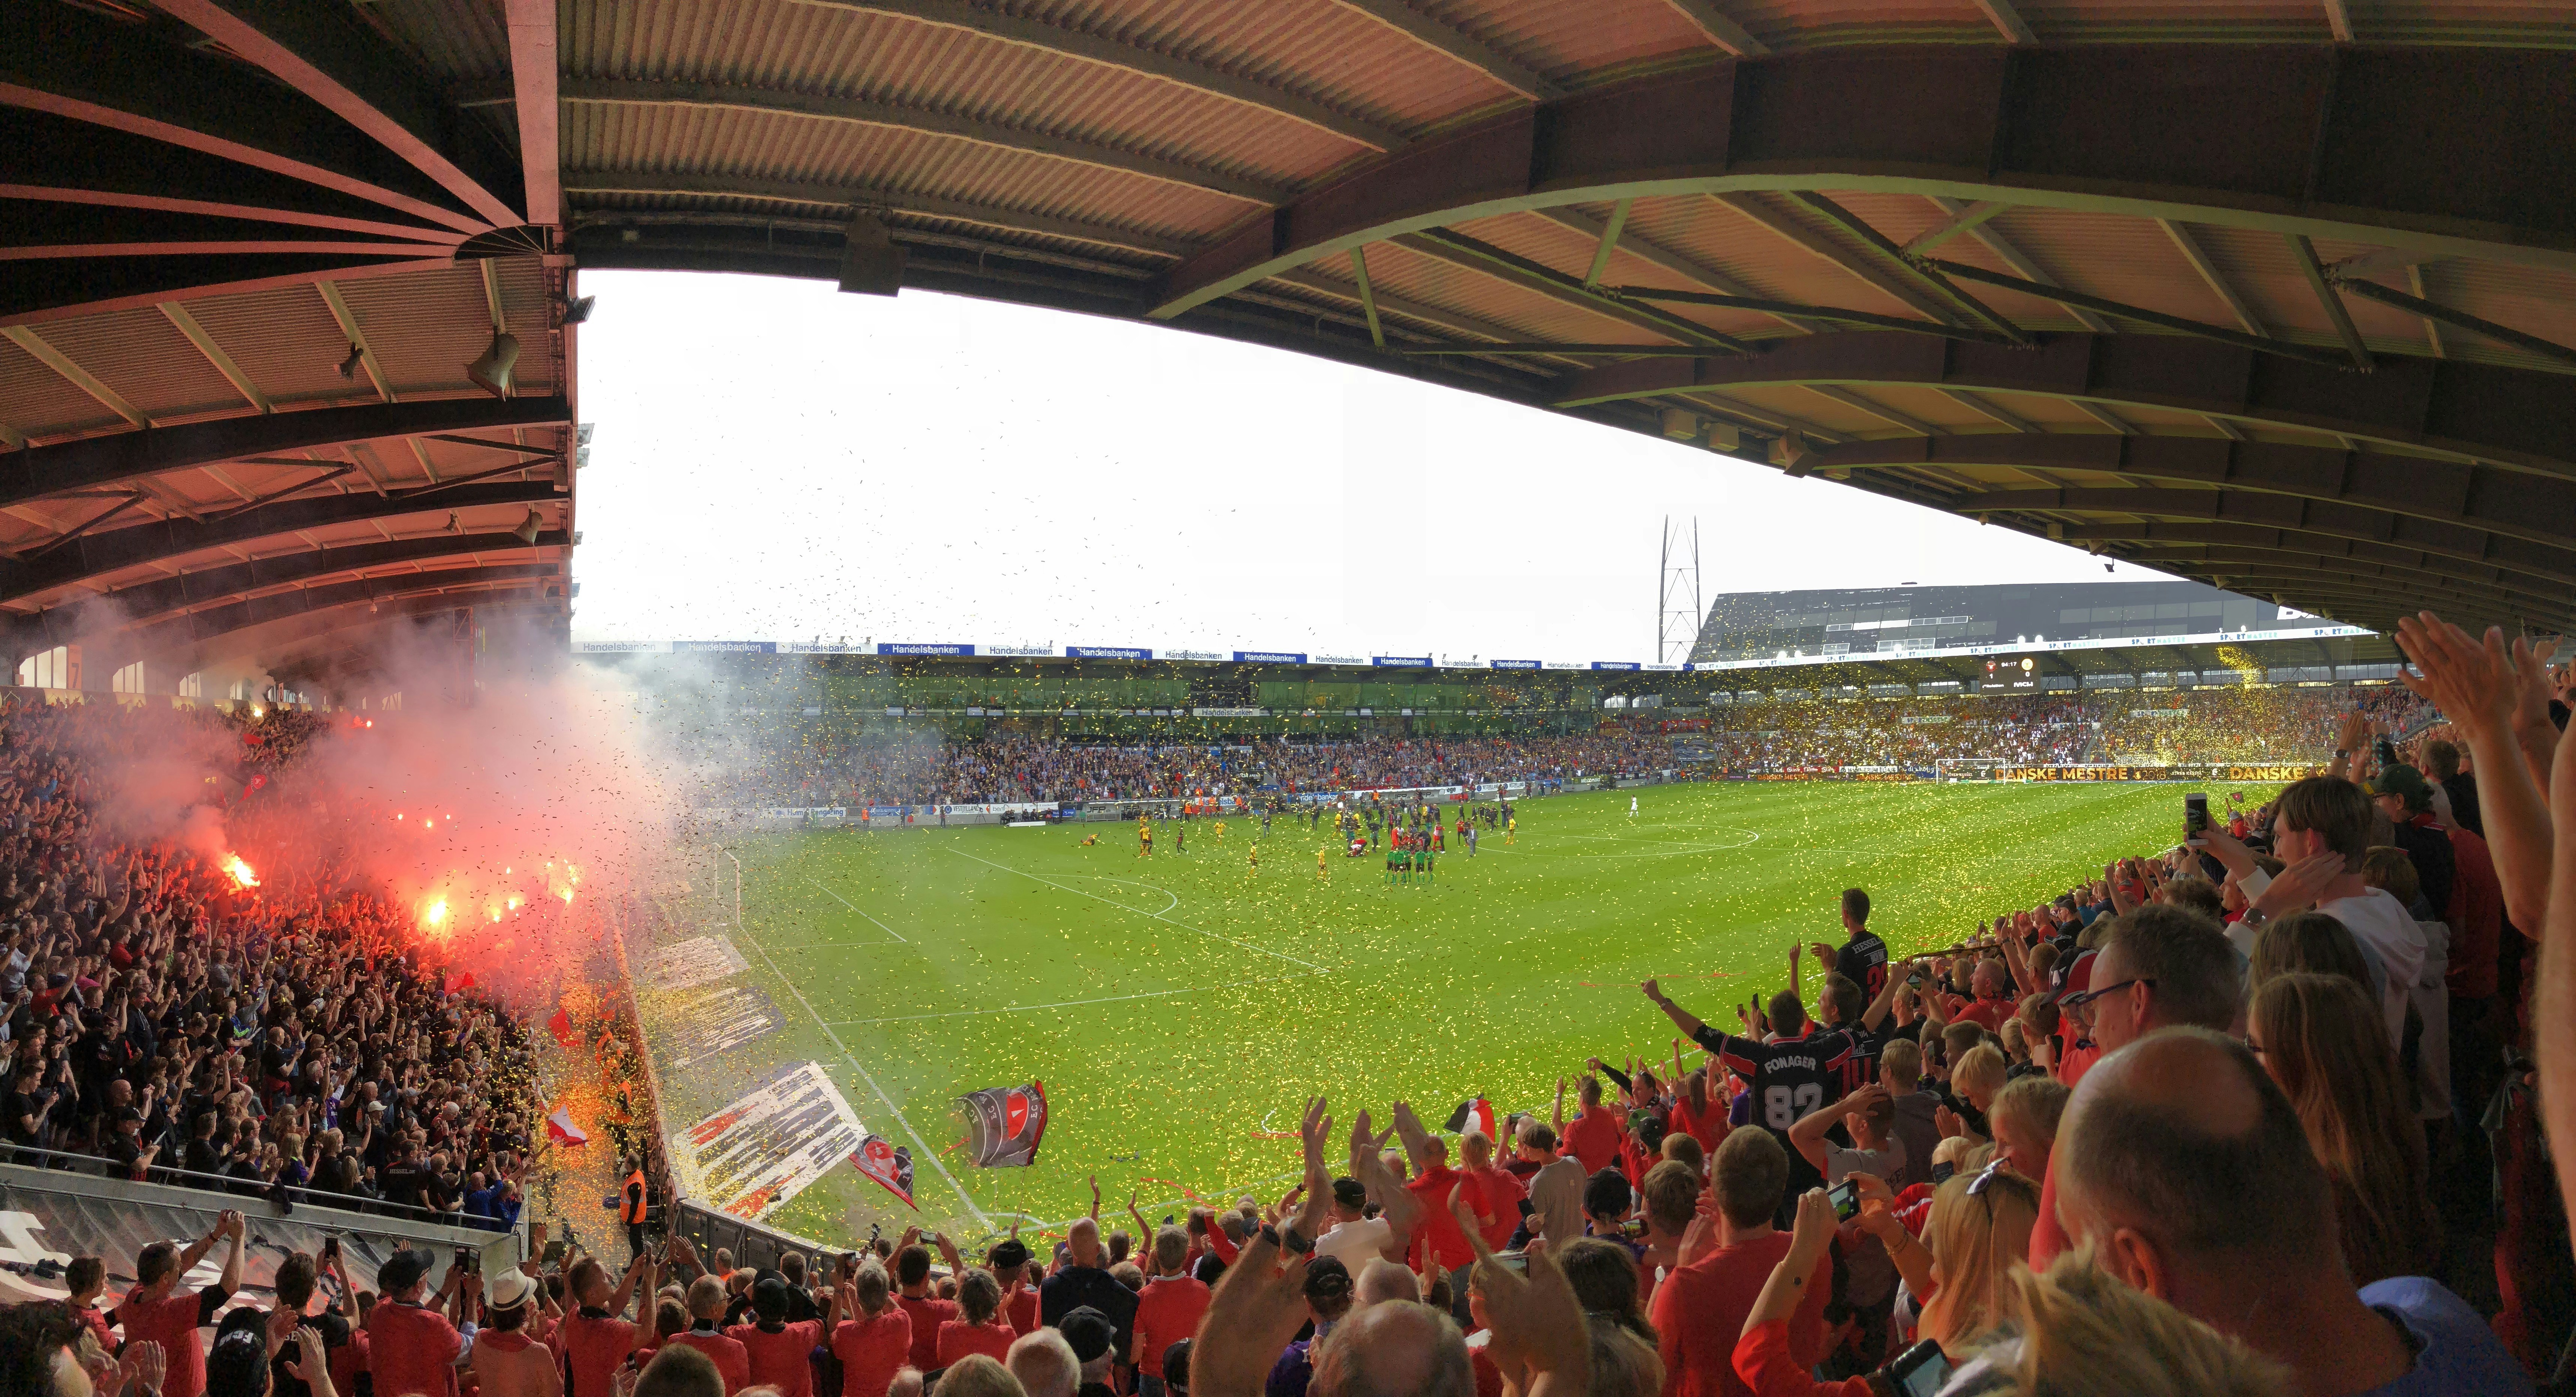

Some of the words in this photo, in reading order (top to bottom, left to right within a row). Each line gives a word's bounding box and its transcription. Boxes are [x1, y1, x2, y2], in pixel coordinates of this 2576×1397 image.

[2314, 627, 2374, 636] SPRTMAS
[2220, 632, 2277, 641] SPRTMASTER
[583, 643, 656, 651] Handelsbanken
[689, 643, 761, 651] Handelsbanken
[791, 644, 861, 652] Handelsbanken
[892, 645, 960, 654] Handelsbanken
[990, 646, 1053, 655] Handelsbanken
[1079, 648, 1140, 657] Handelsbanken
[1165, 651, 1222, 660] Handelsbanken
[1245, 654, 1296, 662] Handelsbanken
[1316, 655, 1363, 664] Handelsbanken
[72, 663, 79, 688] 7
[1996, 768, 2057, 780] DANSKE
[2062, 767, 2127, 780] MESTRE
[2142, 770, 2166, 780] 2018
[2230, 767, 2305, 780] DANSKE
[1764, 1056, 1816, 1074] FONAGER
[1765, 1082, 1823, 1130] 82
